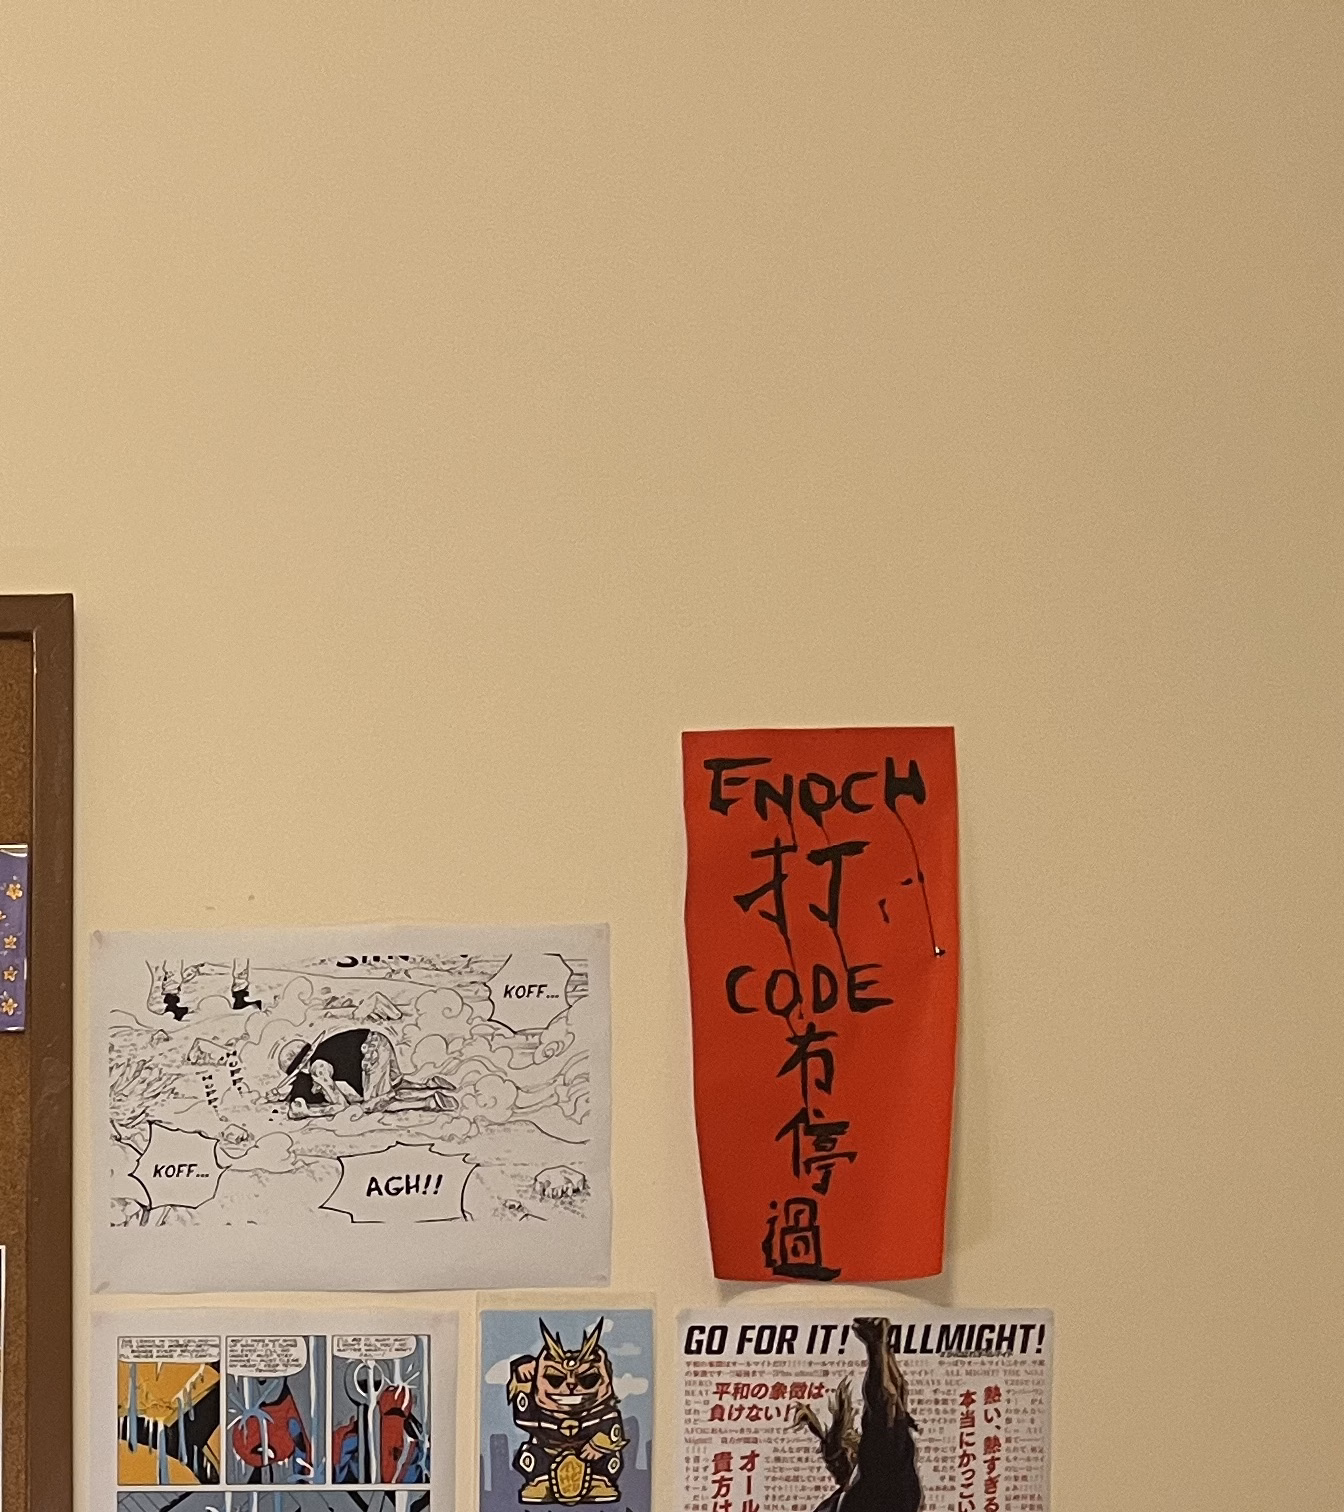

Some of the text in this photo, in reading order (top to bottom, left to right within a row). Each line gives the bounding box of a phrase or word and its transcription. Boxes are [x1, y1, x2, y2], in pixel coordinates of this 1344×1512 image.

[703, 755, 927, 818] ENOCH
[733, 837, 872, 936] 打
[503, 984, 560, 999] KOFF...
[726, 964, 893, 1015] CODE
[153, 1163, 210, 1178] KOFF...
[366, 1174, 442, 1197] AGH!!
[684, 1323, 1046, 1355] GO FOR IT! ALLMIGHT!
